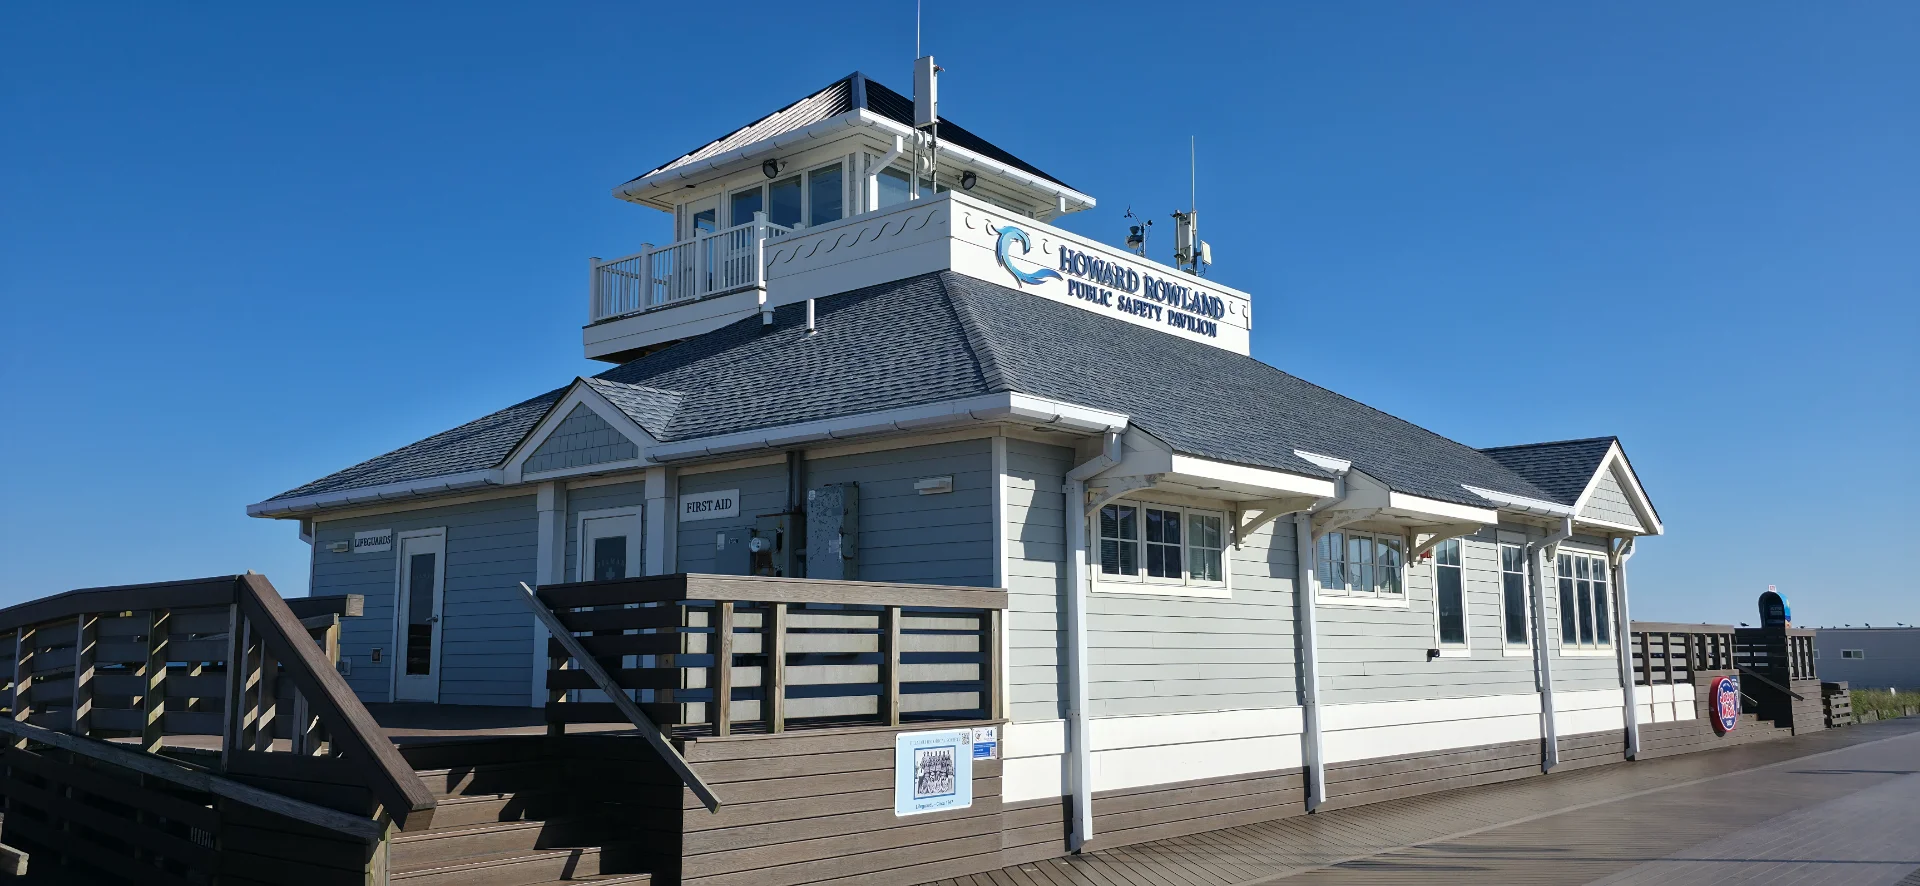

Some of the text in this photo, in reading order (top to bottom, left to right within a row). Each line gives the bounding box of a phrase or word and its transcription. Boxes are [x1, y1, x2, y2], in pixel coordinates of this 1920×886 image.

[1059, 244, 1225, 320] HOWARD ROWLAND
[1067, 278, 1218, 338] PUBLIC SAFETY PAVILION
[686, 498, 732, 513] FIRST AID
[355, 535, 391, 548] LIFEGUARDS
